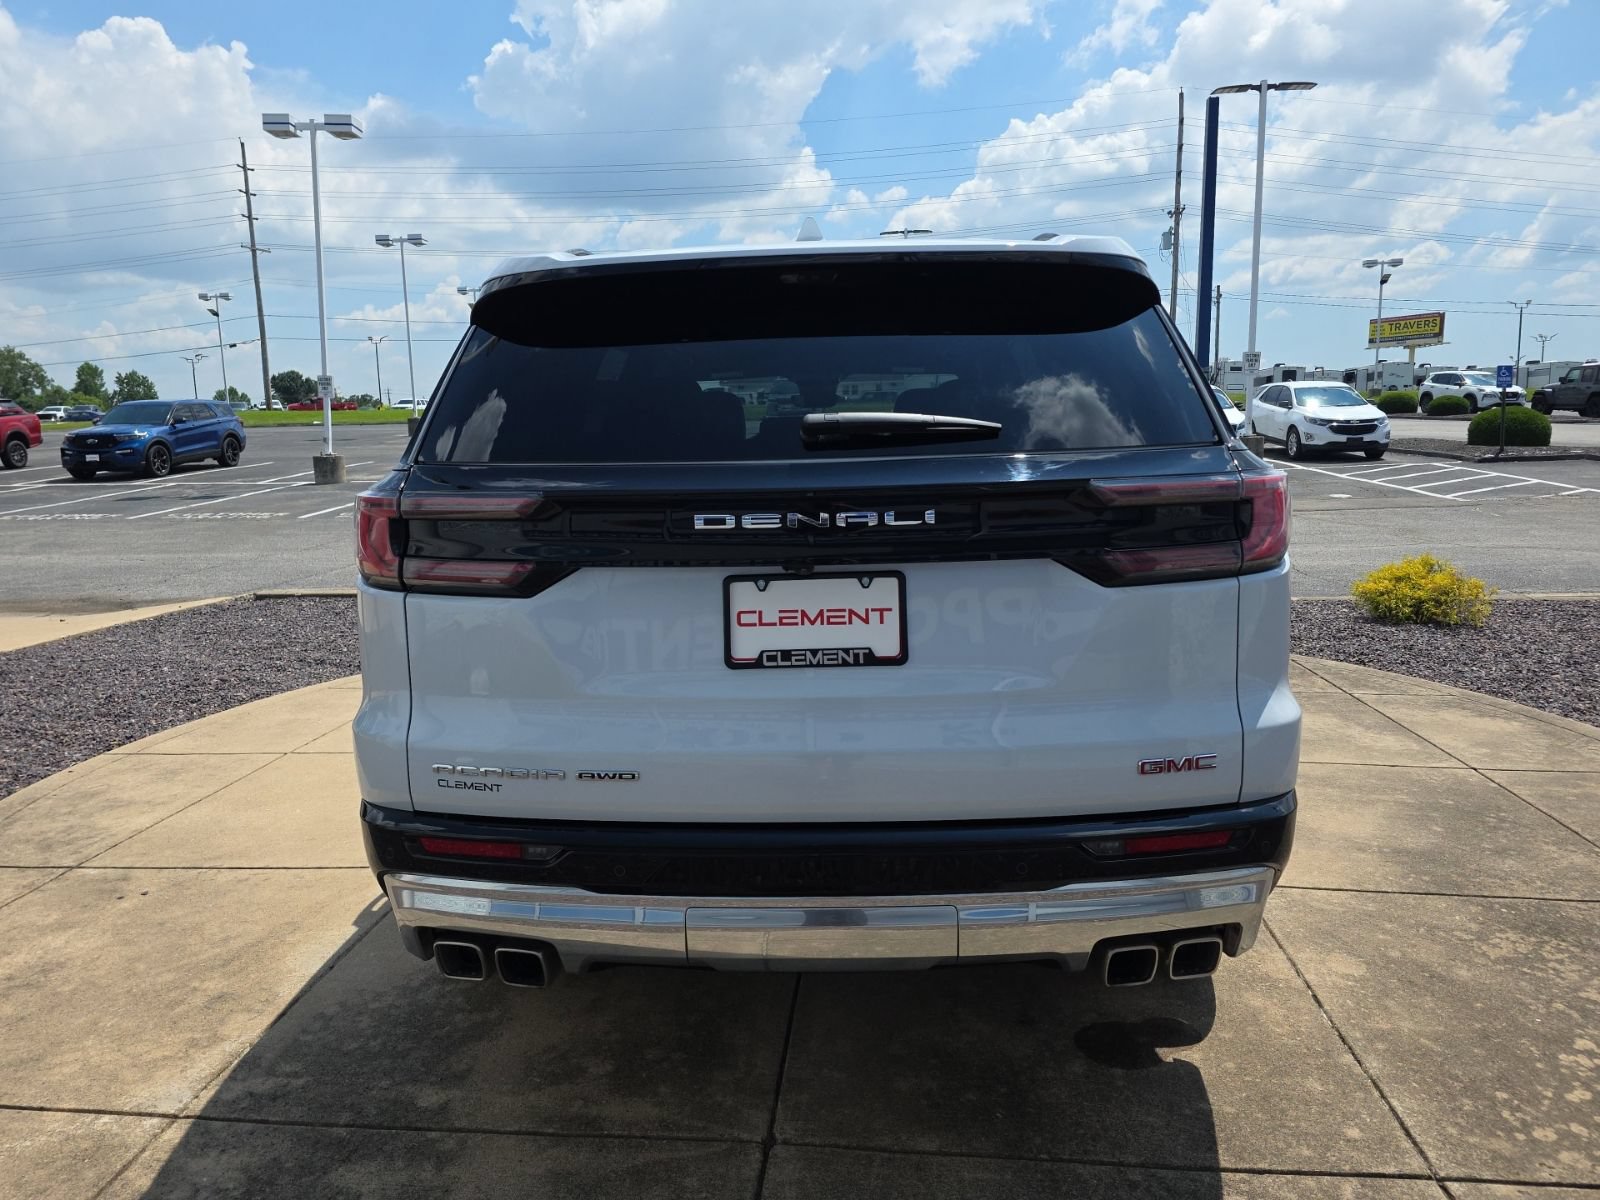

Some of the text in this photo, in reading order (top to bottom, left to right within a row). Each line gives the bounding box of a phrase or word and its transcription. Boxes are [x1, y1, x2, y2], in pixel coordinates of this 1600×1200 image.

[1389, 318, 1438, 332] TRAVERS
[694, 508, 936, 530] DENALI
[736, 607, 893, 627] CLEMENT
[762, 649, 869, 666] CLEMENT
[432, 763, 640, 781] ACADIA AWD
[1137, 753, 1218, 776] GMC
[437, 778, 503, 793] CLEMENT
